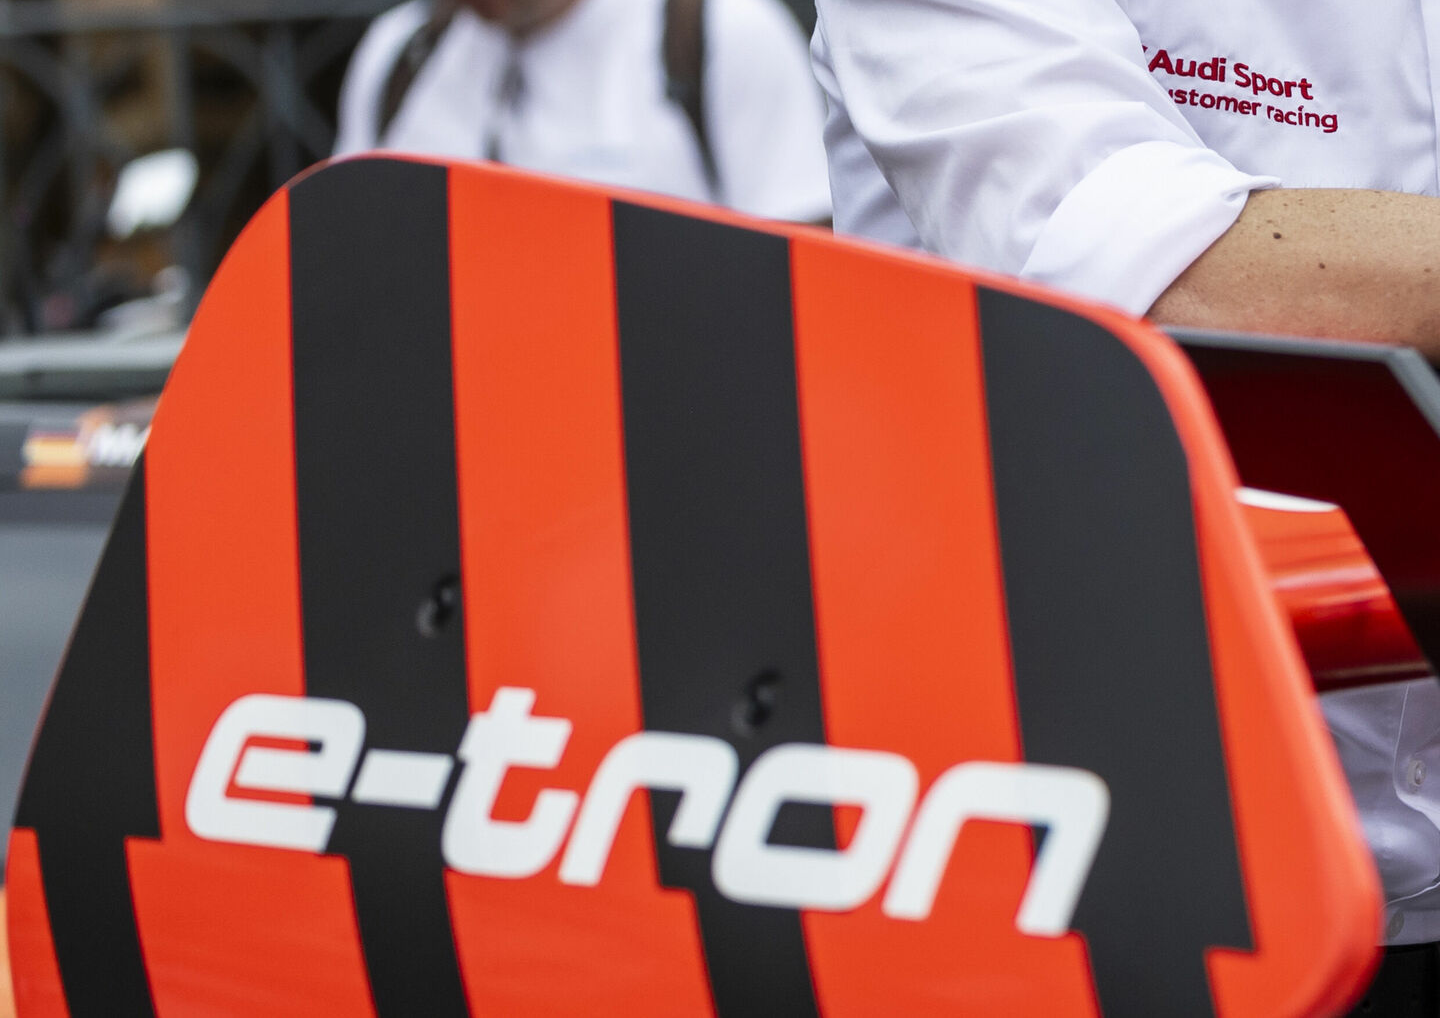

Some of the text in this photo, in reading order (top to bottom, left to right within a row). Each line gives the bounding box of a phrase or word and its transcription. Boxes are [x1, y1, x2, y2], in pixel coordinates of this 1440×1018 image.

[1147, 48, 1314, 101] Audi Sport
[1267, 105, 1339, 134] racing
[184, 685, 1111, 938] e-tron
